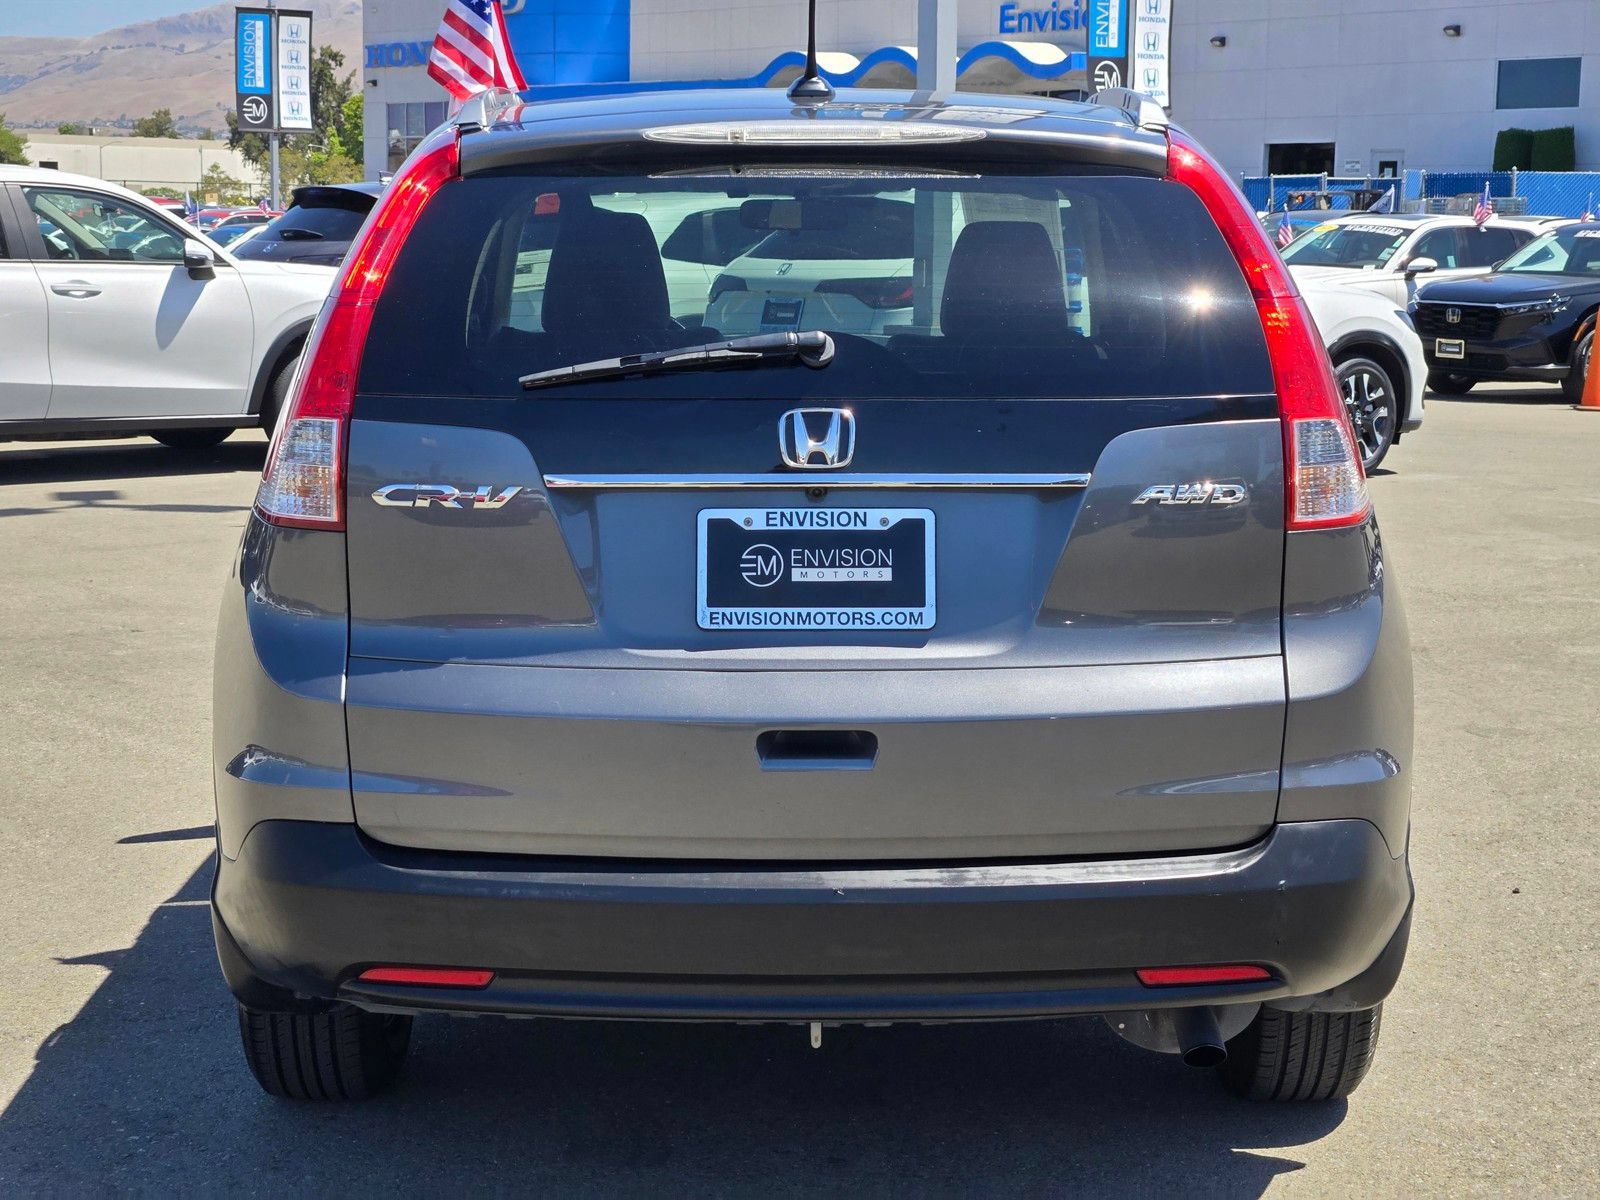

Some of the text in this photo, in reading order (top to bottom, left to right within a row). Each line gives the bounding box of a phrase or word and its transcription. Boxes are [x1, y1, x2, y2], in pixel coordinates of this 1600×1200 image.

[999, 0, 1088, 34] Envisi
[1095, 0, 1109, 48] ENVI
[243, 20, 256, 88] ENVISION
[365, 41, 433, 68] HON
[371, 483, 523, 509] CR-V
[1131, 483, 1246, 505] AWD
[765, 511, 868, 528] ENVISION
[791, 548, 893, 567] ENVISION
[799, 570, 884, 579] MOTORS
[709, 611, 924, 626] ENVISIONMOTORS.COM
